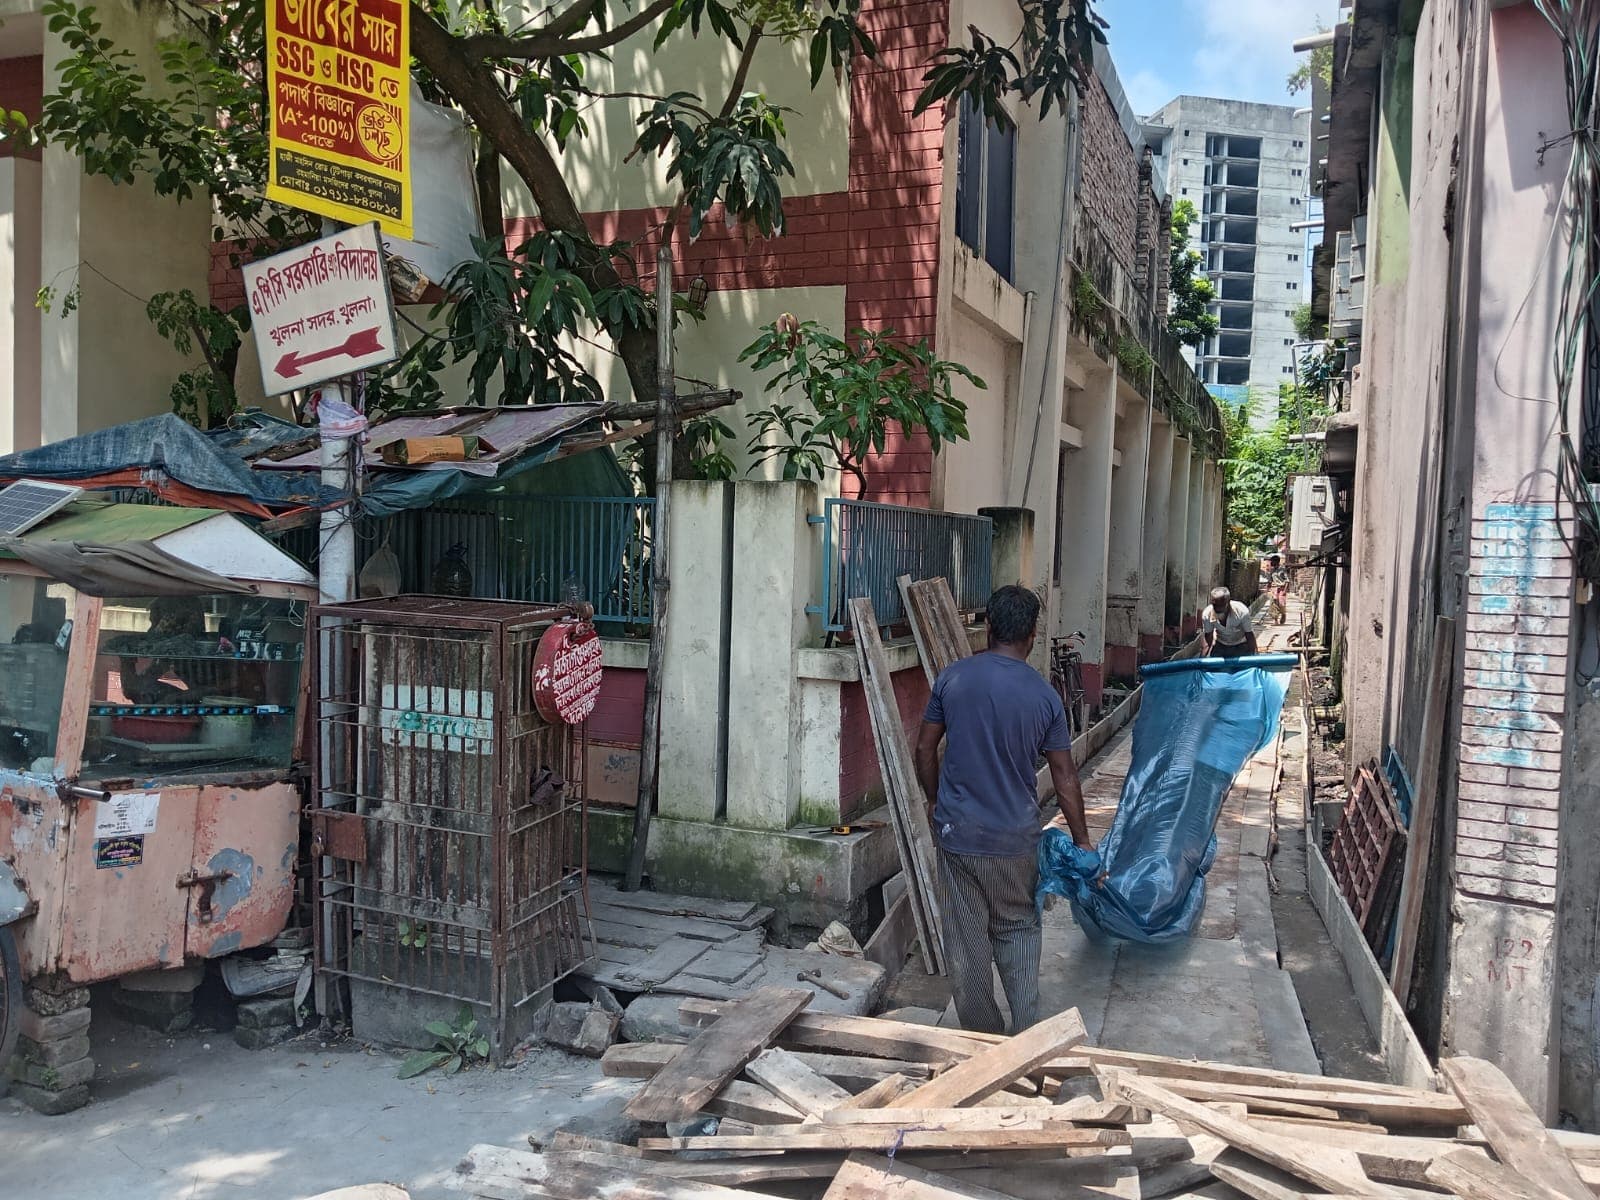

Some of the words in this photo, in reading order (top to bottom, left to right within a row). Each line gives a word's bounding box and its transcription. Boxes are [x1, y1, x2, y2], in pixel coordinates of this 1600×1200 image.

[360, 12, 398, 57] স্যার
[276, 36, 315, 77] SSC
[319, 58, 332, 78] ও
[336, 53, 374, 94] HSC
[379, 75, 399, 99] তে
[279, 80, 311, 108] পদার্থ
[313, 85, 355, 120] বিজ্ঞানে
[301, 131, 335, 149] পেতে
[282, 246, 331, 294] সরকারি
[335, 240, 378, 283] বিদ্যালয়
[269, 317, 305, 347] খুলনা
